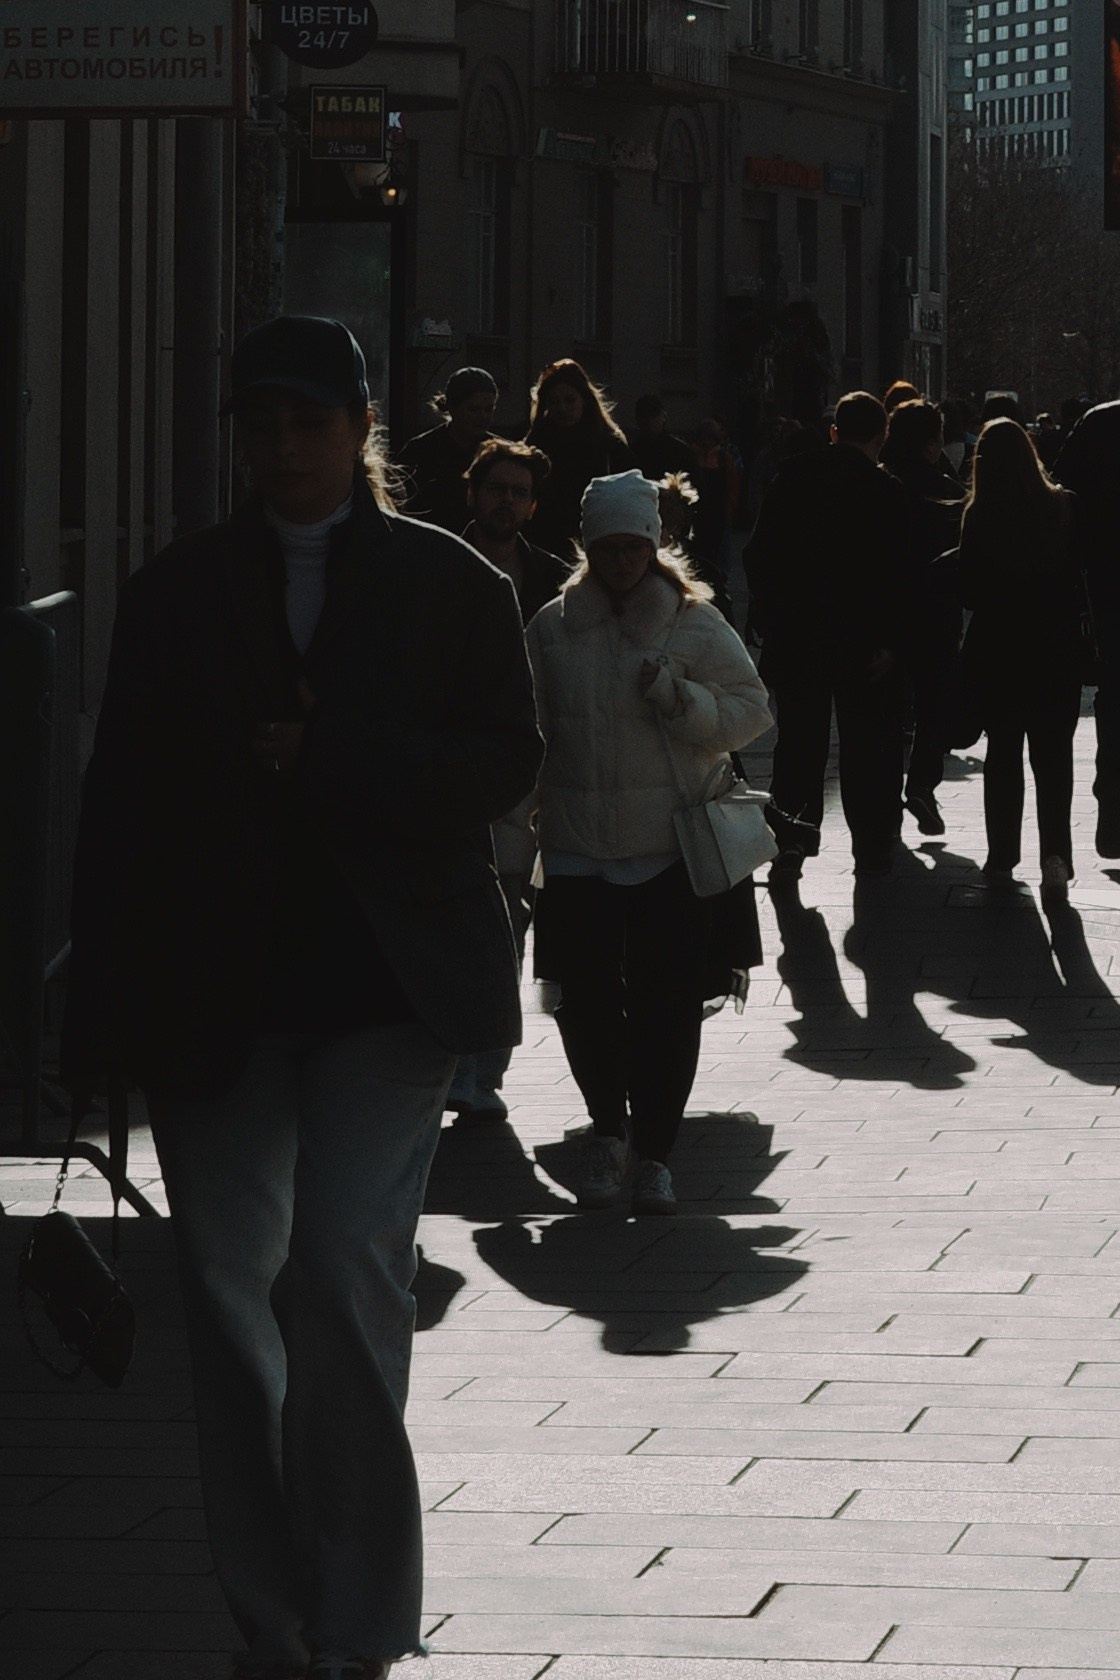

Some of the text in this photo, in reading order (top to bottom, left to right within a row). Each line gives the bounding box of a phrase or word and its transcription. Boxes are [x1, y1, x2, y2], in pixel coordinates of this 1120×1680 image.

[281, 6, 369, 27] ЦВЕТЫ
[3, 26, 206, 48] БЕРЕГИСЬ
[298, 31, 350, 49] 24/7
[3, 57, 208, 80] АВТОМОБИЛЯ
[315, 96, 381, 113] ТАБАК
[328, 142, 367, 154] 24 часа
